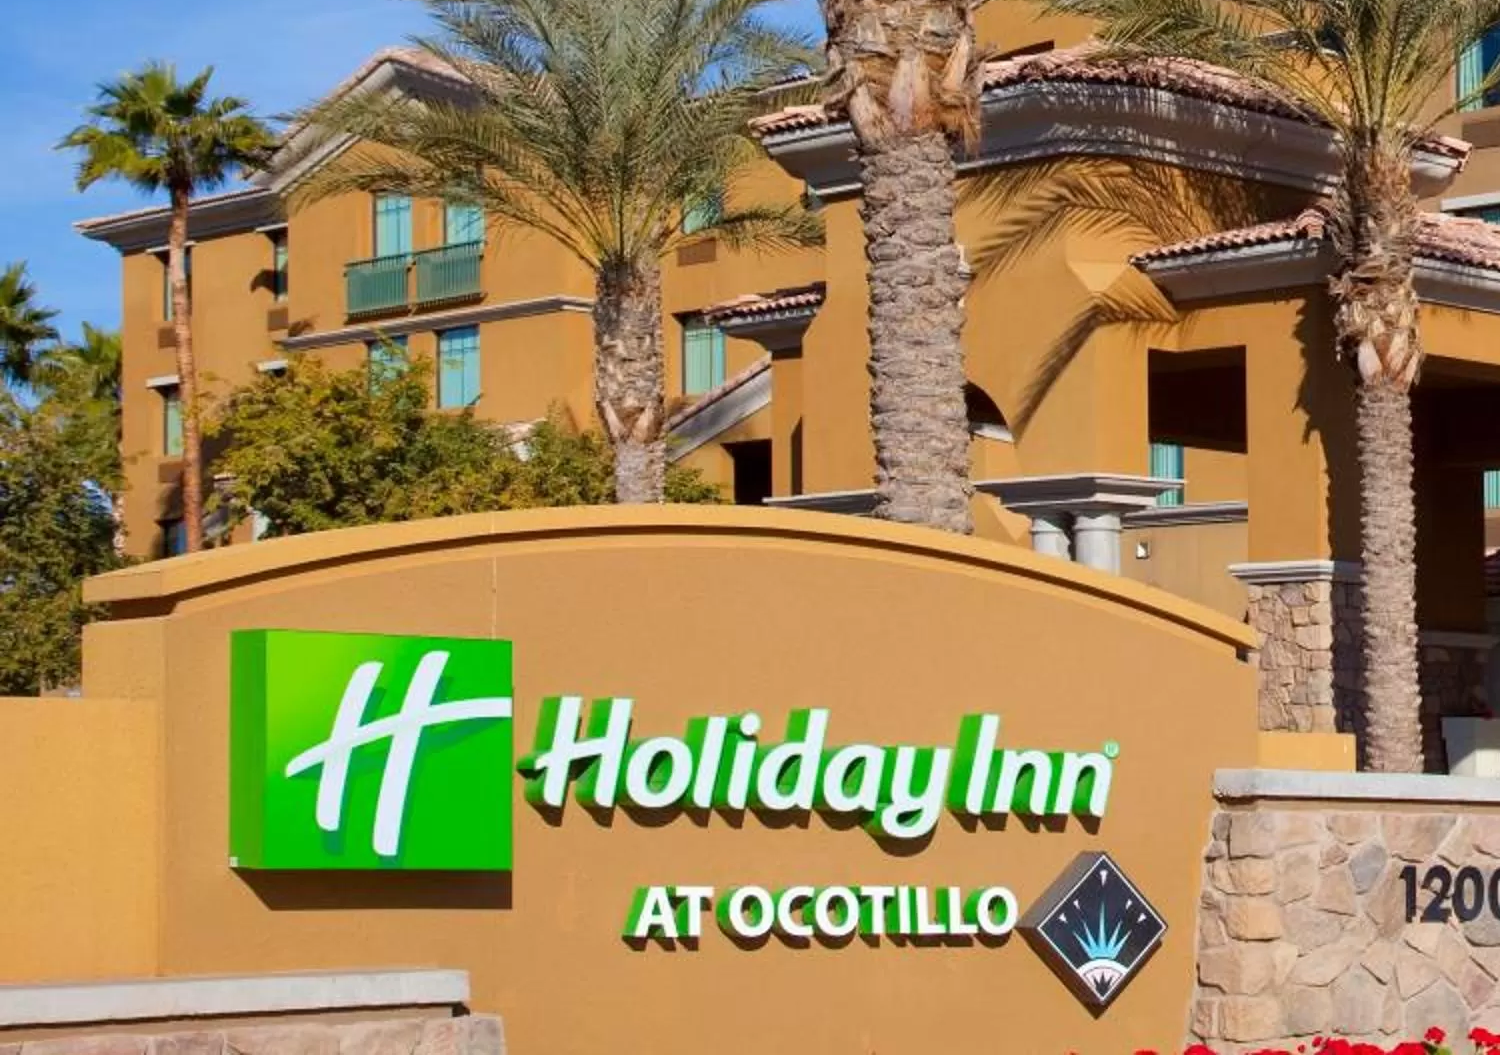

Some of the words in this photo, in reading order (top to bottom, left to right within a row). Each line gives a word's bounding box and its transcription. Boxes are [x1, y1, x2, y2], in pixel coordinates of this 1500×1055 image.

[533, 695, 951, 838] Holiday
[960, 713, 1113, 817] Inn
[632, 886, 713, 937] AT
[727, 886, 1018, 937] OCOTILLO
